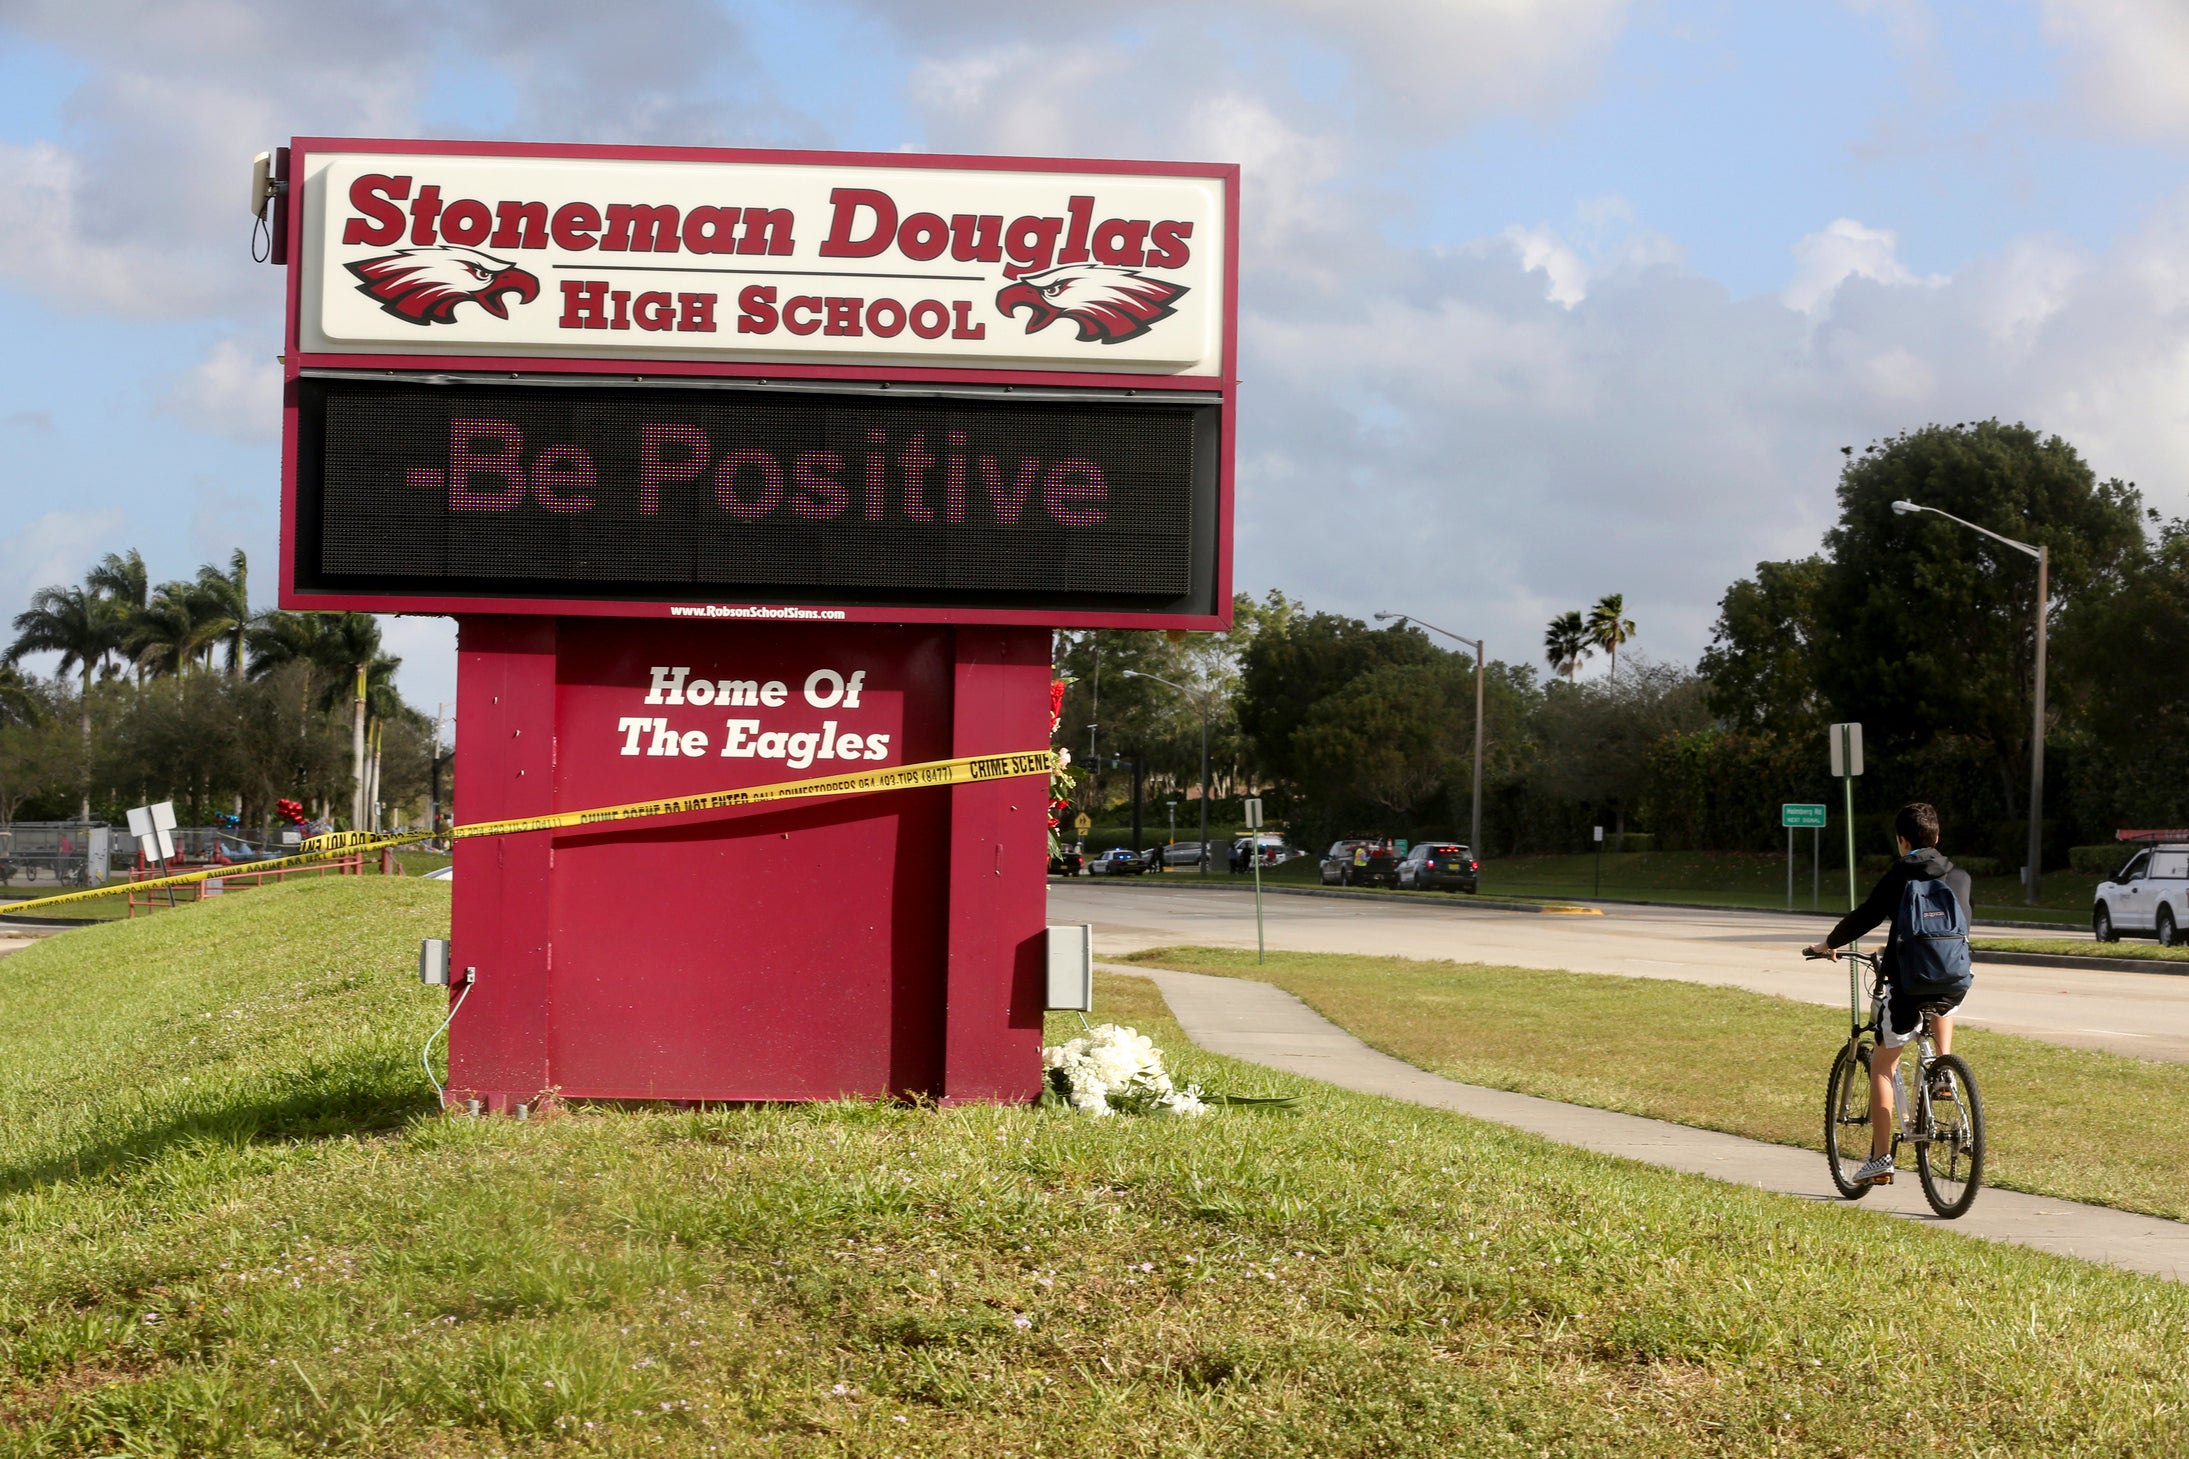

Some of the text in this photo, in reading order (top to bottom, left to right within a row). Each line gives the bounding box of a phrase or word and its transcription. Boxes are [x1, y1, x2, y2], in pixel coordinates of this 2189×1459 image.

[343, 173, 1194, 281] Stoneman Douglas
[640, 422, 1109, 527] Positive
[671, 605, 845, 619] www.RobsonSchoolSigns.com
[644, 667, 866, 708] Home Of
[618, 717, 890, 769] The Eagles
[922, 765, 953, 784] (8477)
[970, 758, 1009, 779] CRIME
[1011, 753, 1050, 774] SCENE
